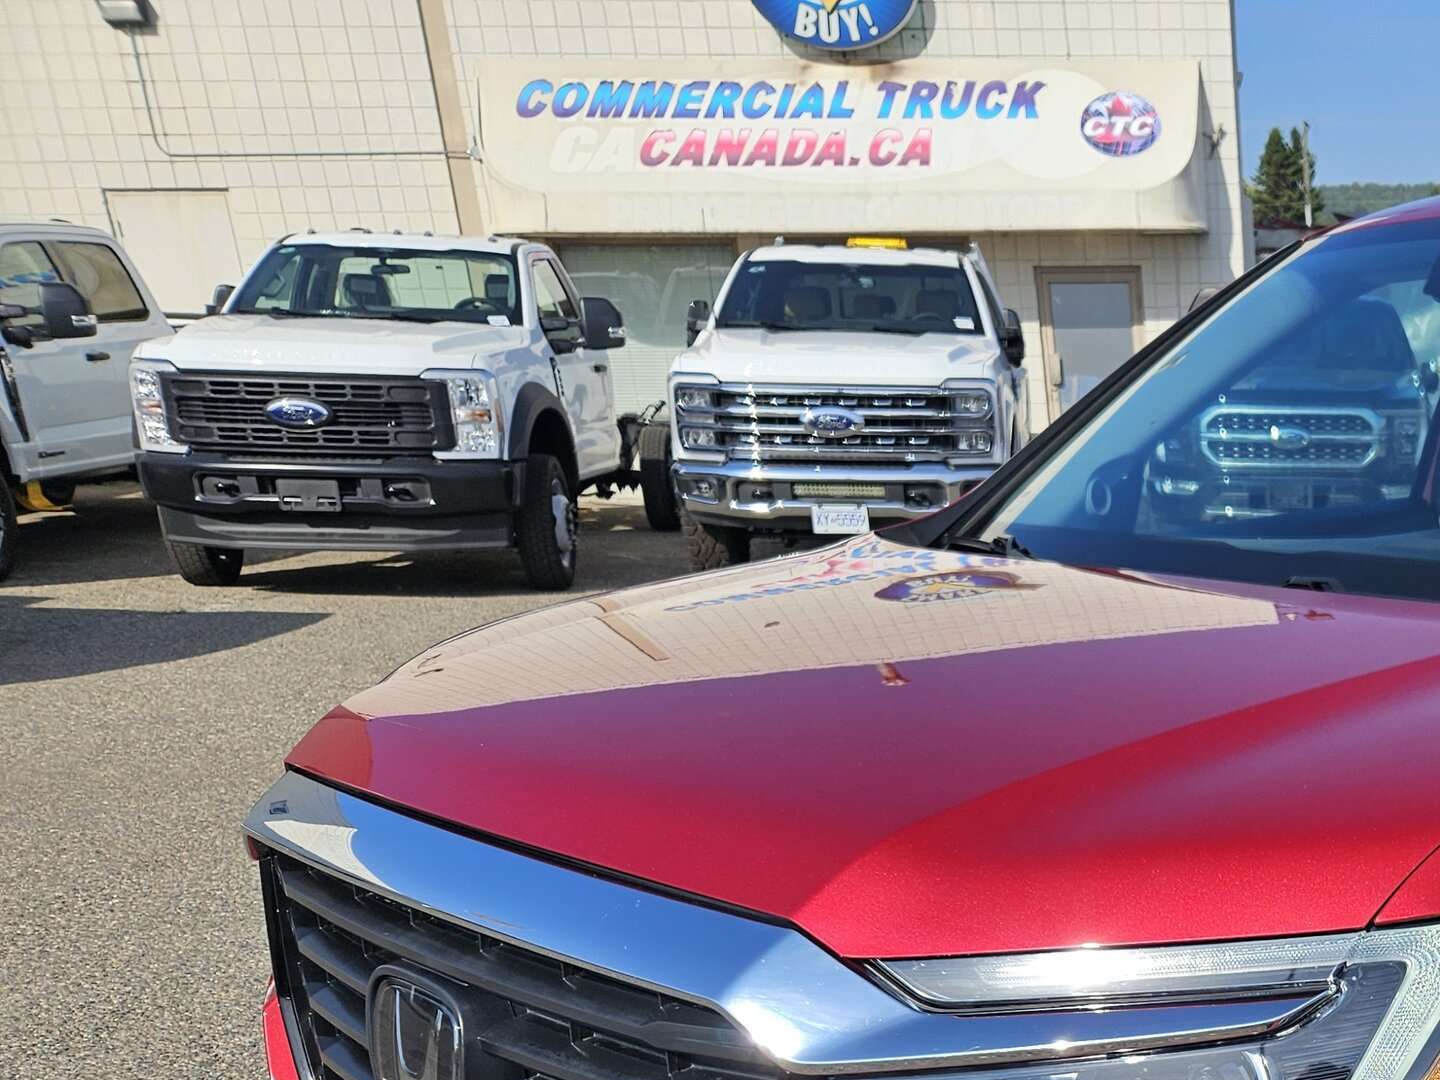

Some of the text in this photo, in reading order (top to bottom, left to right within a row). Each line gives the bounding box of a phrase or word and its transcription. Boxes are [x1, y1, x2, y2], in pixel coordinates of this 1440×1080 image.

[794, 3, 879, 43] BUY!
[515, 79, 1048, 120] COMMERCIAL TRUCK
[1083, 116, 1154, 137] CTC
[639, 127, 934, 168] CANADA.CA
